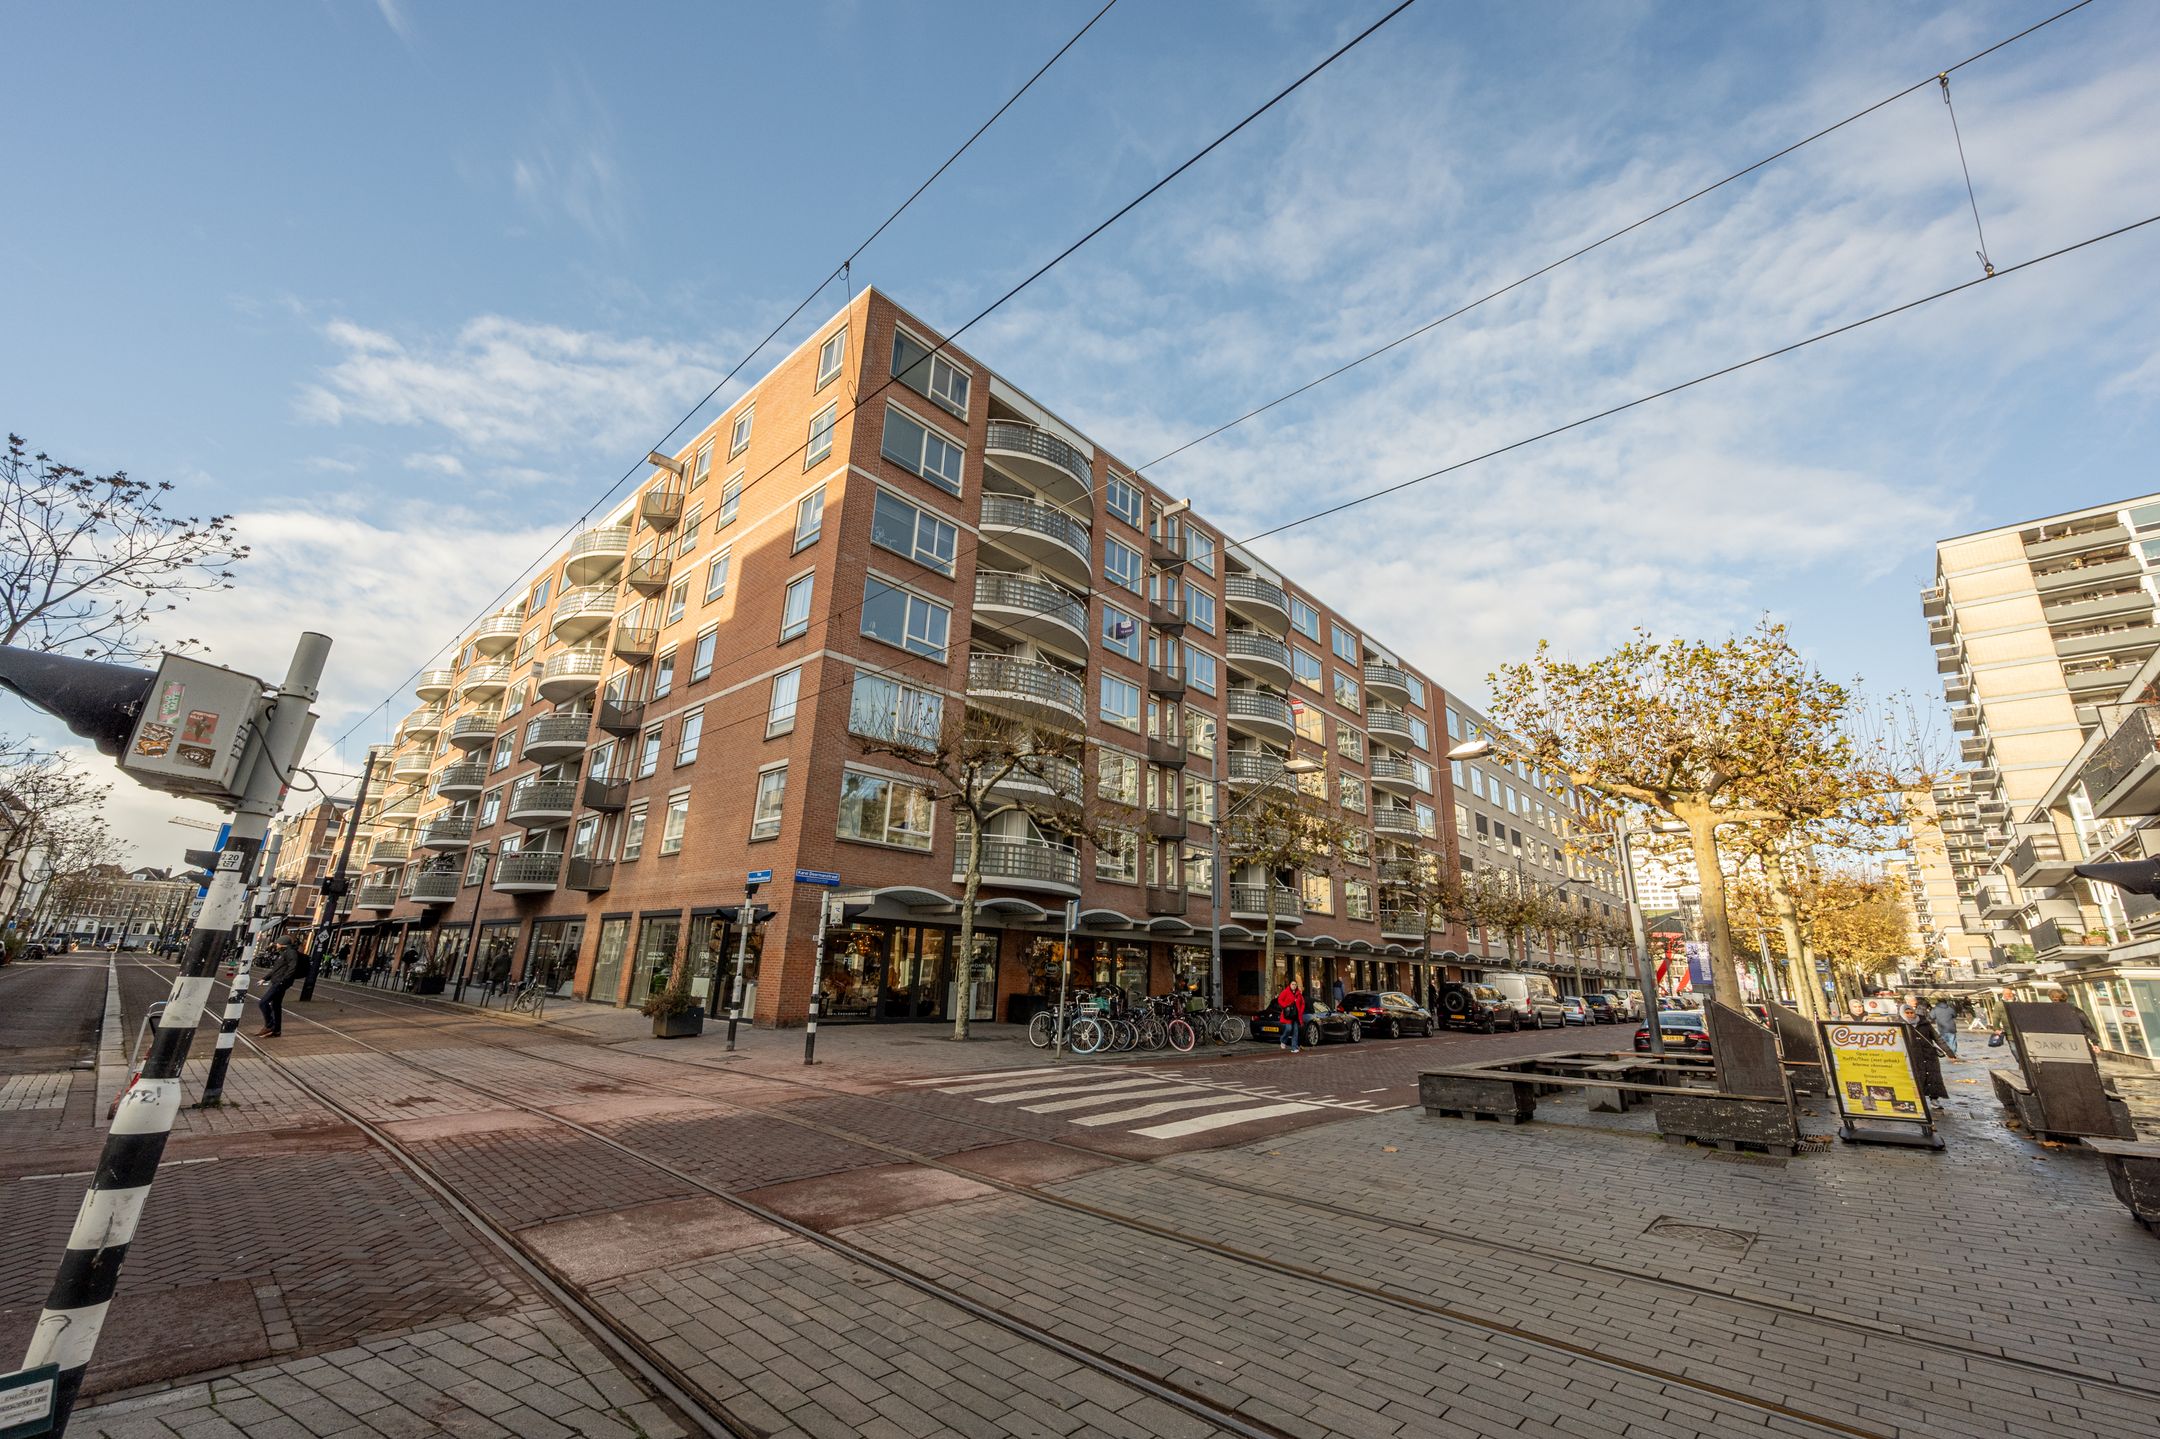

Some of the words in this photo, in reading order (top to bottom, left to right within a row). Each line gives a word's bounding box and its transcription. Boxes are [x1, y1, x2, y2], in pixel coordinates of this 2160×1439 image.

[169, 690, 181, 711] MATE
[1832, 1026, 1897, 1047] Capri
[2069, 1042, 2079, 1051] U
